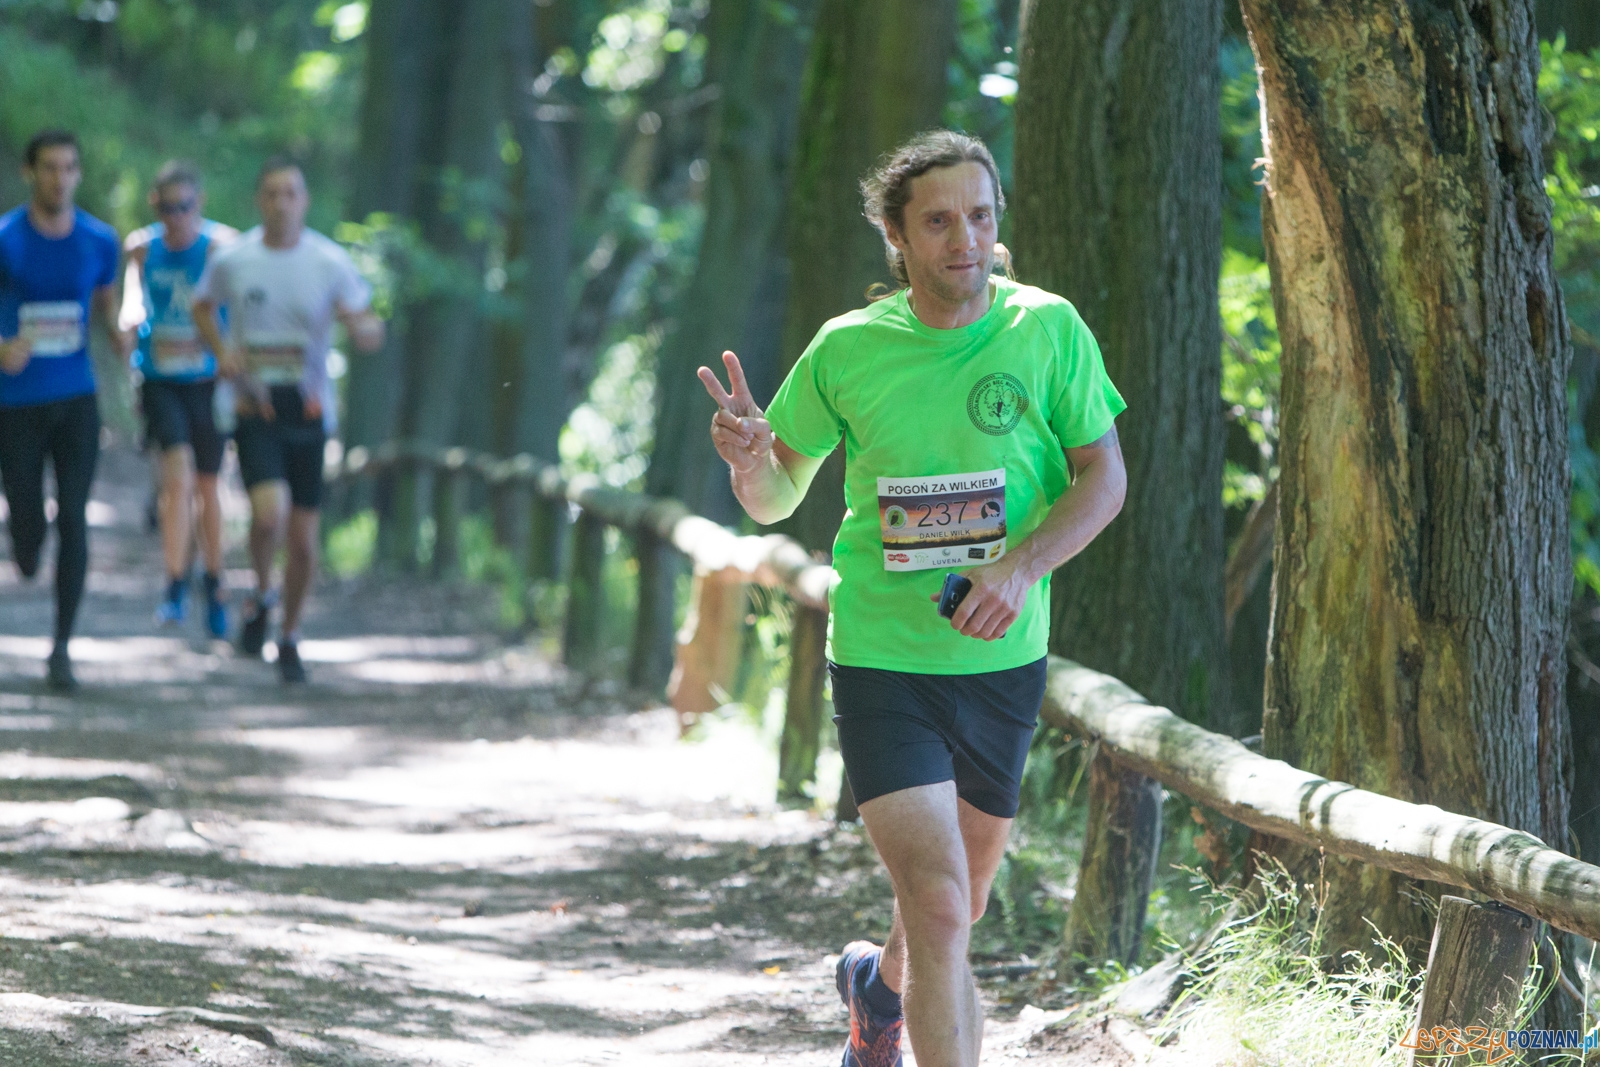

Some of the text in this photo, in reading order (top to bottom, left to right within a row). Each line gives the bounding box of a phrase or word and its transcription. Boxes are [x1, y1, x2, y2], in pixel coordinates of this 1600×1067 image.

[888, 477, 998, 495] POGOŃ ZA WILKIEM
[916, 500, 969, 528] 237
[919, 529, 971, 540] DANIEL WILK
[932, 557, 962, 566] LUVENA
